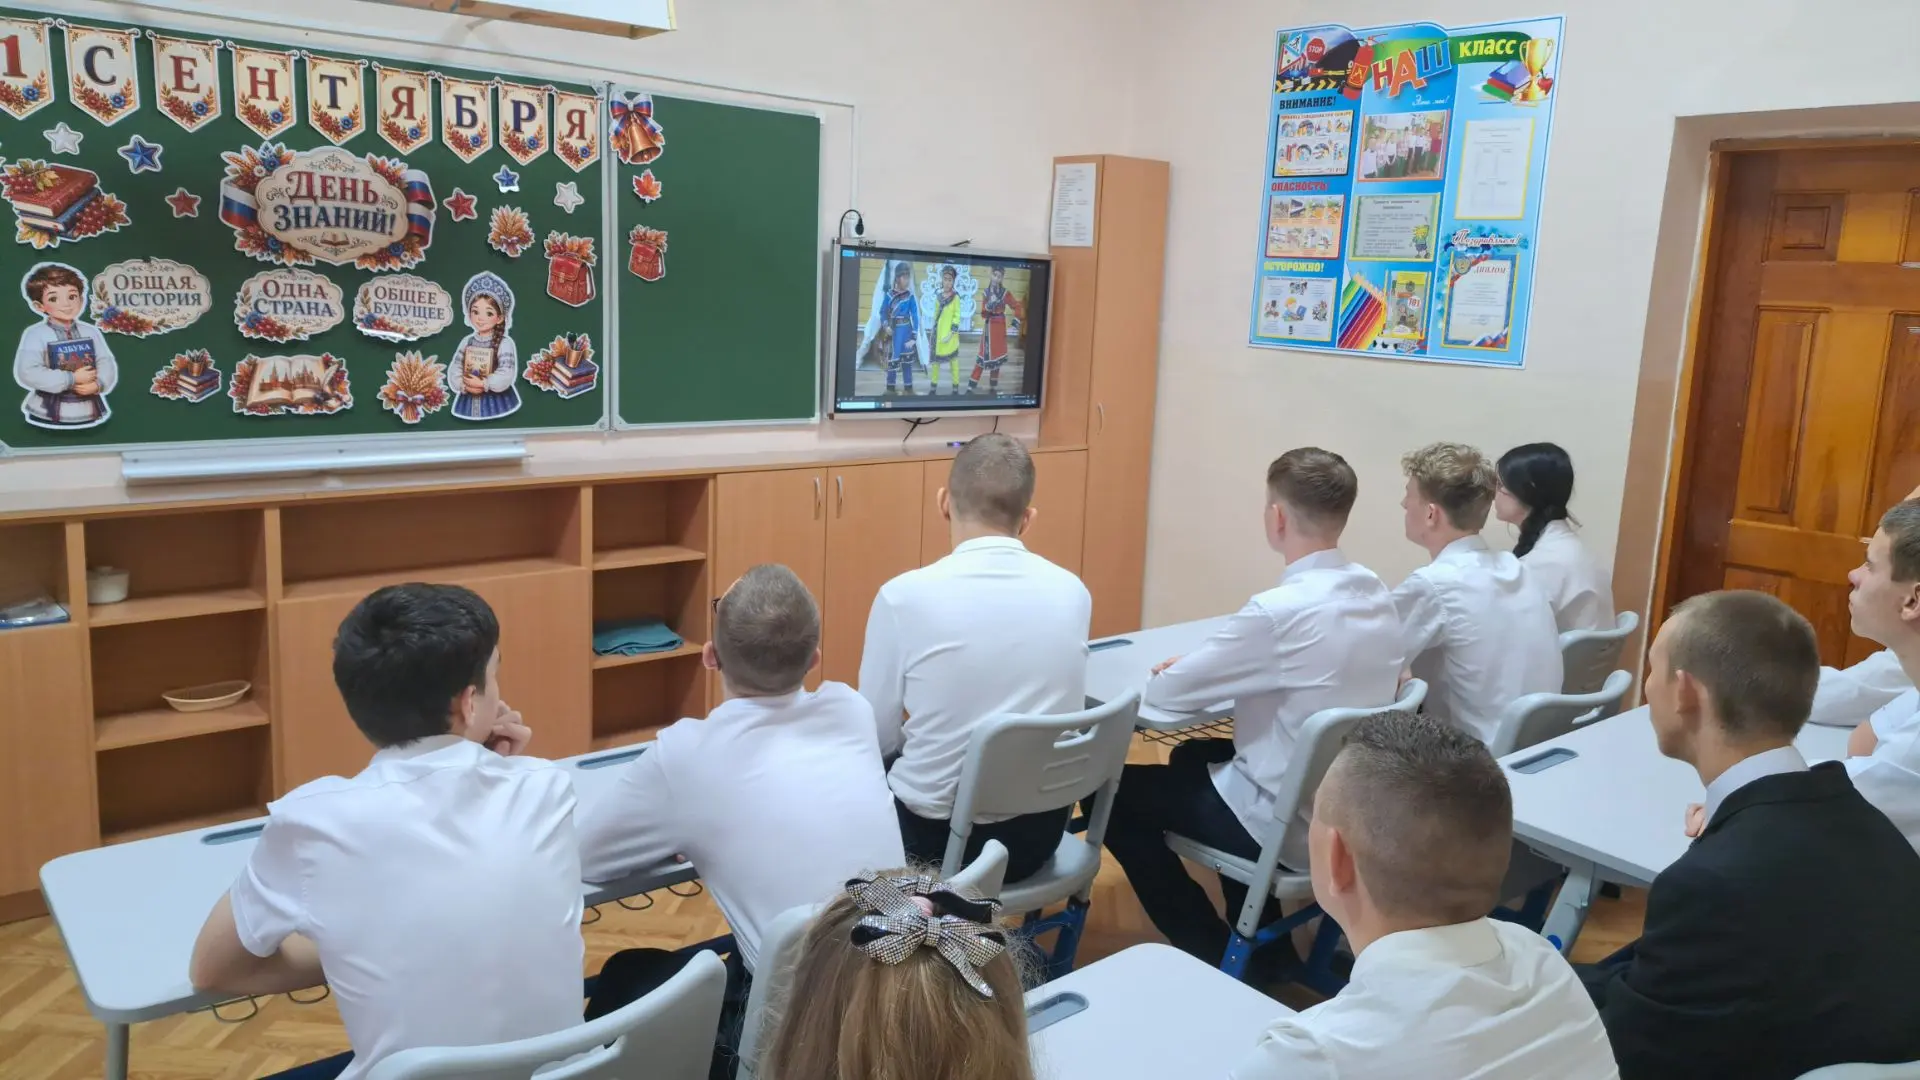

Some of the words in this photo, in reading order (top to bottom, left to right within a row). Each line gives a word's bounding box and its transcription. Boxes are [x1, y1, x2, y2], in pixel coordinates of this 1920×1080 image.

[0, 34, 27, 79] 1
[1309, 46, 1323, 54] STOP
[1371, 40, 1452, 98] НАШ
[1279, 96, 1337, 110] ВНИМАНИЕ!
[286, 171, 379, 205] ДЕНЬ
[273, 204, 397, 236] ЗНАНИЙ!
[1264, 261, 1325, 273] ОСТОРОЖНО!
[113, 274, 197, 291] ОБЩАЯ
[262, 279, 328, 300] ОДНА
[113, 292, 202, 307] ИСТОРИЯ
[374, 285, 438, 306] ОБЩЕЕ
[253, 299, 336, 318] СТРАНА
[373, 302, 446, 321] БУДУЩЕЕ
[57, 343, 91, 354] АЗБУКА
